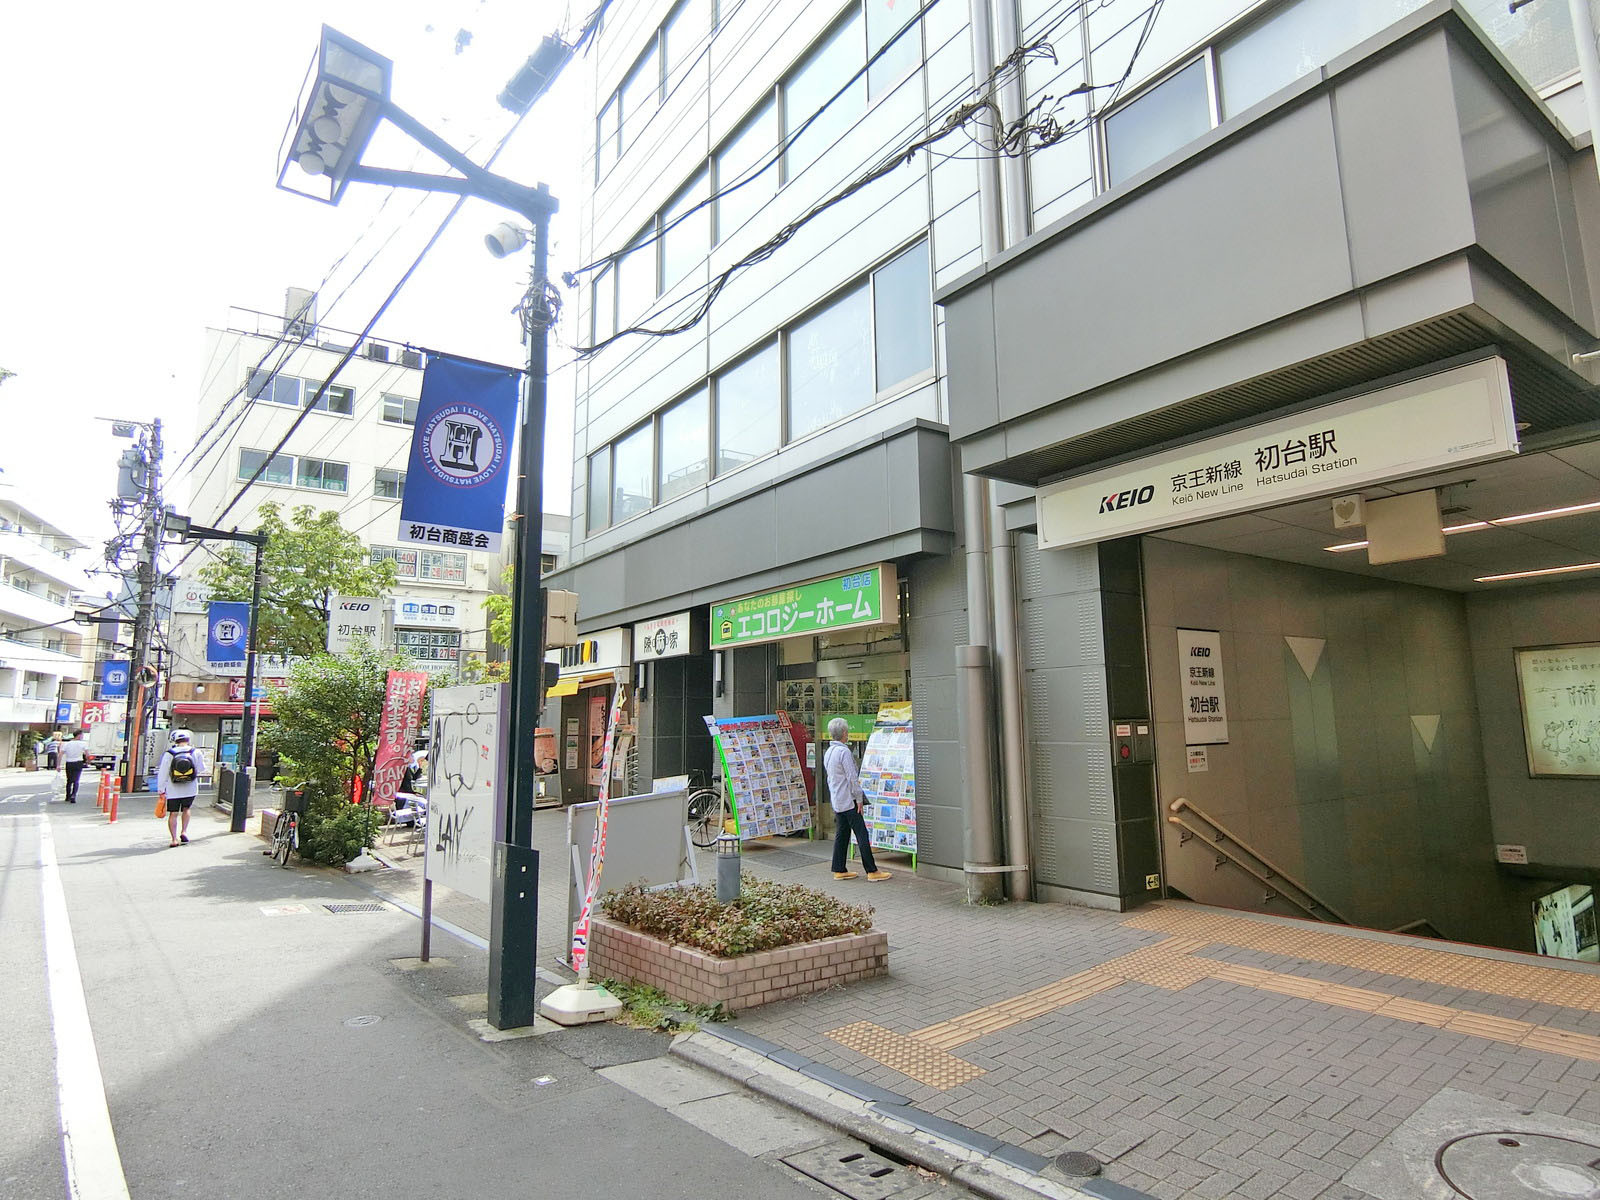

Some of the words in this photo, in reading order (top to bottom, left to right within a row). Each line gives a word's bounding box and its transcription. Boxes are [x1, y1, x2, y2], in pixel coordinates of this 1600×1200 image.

[425, 406, 459, 435] HATSUDAI
[468, 407, 489, 423] LOVE
[487, 422, 503, 463] HATSUDAI
[440, 419, 483, 473] H
[1254, 429, 1338, 473] 初台駅
[431, 466, 473, 485] HATSUDAI
[474, 468, 494, 483] LOVE
[1171, 459, 1243, 493] 京王新線
[1256, 467, 1308, 487] Hatsudai
[1312, 456, 1358, 475] Station
[1098, 485, 1155, 514] KEIO
[1196, 488, 1219, 502] New
[1221, 482, 1244, 495] Line
[410, 524, 489, 549] 初台商盛会
[842, 573, 872, 591] 初台店
[340, 602, 370, 611] KEIO
[738, 590, 872, 638] エコロジーホーム
[338, 624, 376, 637] 初台駅
[1190, 647, 1211, 658] KEIO
[1189, 667, 1215, 678] 京王新線
[1190, 696, 1220, 713] 初台駅
[376, 764, 408, 783] TAK
